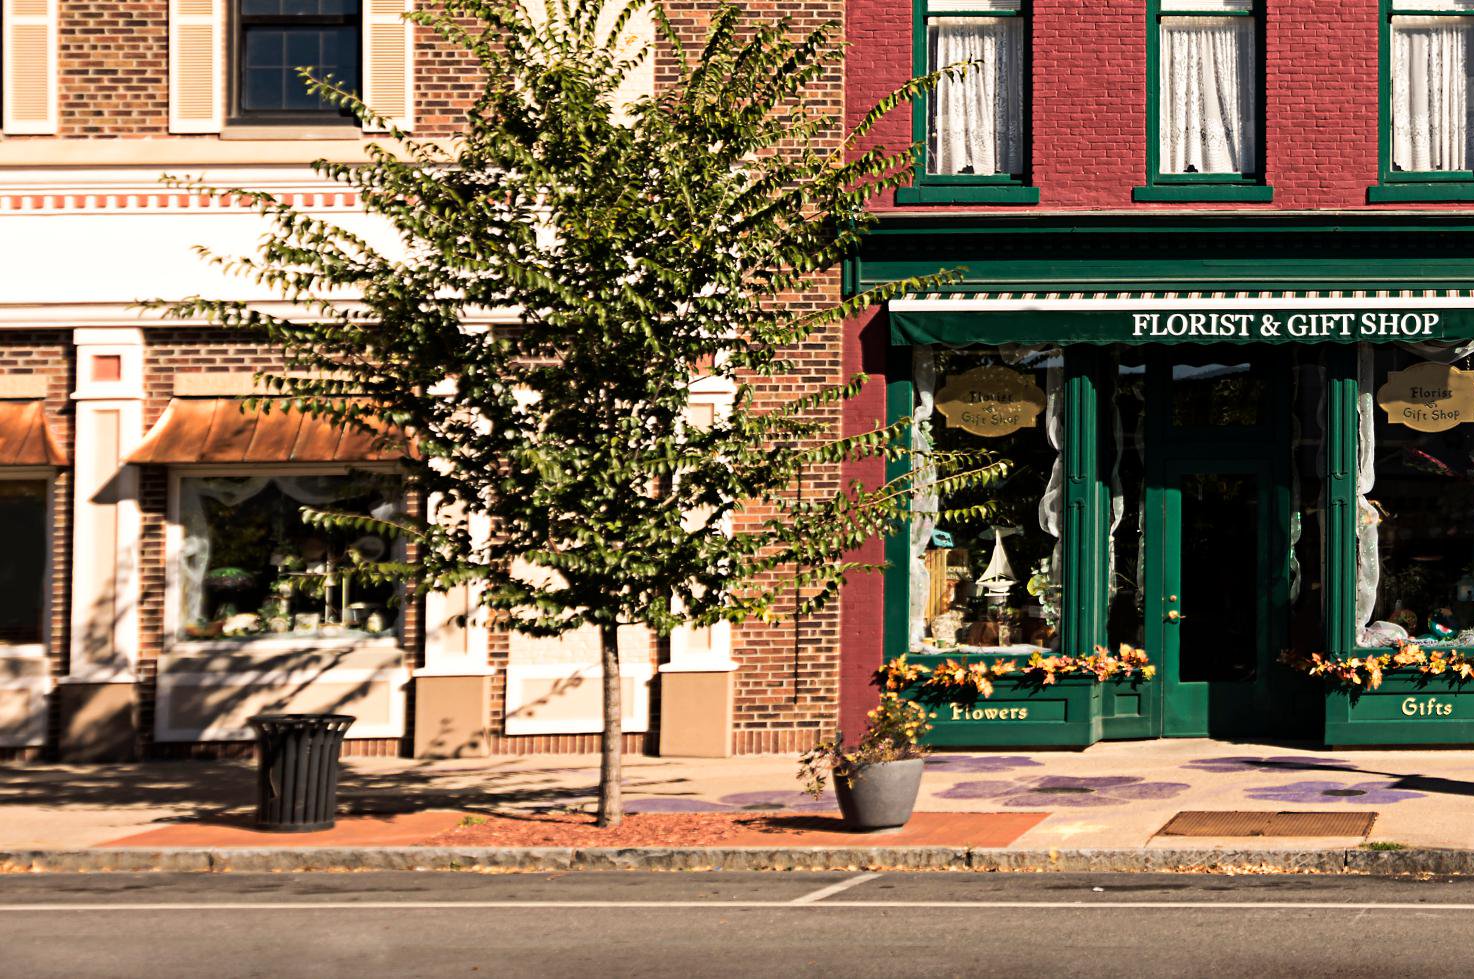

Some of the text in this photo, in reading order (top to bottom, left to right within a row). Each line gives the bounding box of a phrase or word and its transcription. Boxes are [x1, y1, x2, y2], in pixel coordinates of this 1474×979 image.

[1132, 313, 1439, 337] FLORIST & GIFT SHOP
[1409, 386, 1453, 399] Florist
[961, 411, 1019, 426] Gift Shop
[1403, 407, 1460, 422] Gift Shop
[1401, 697, 1453, 716] Gifts
